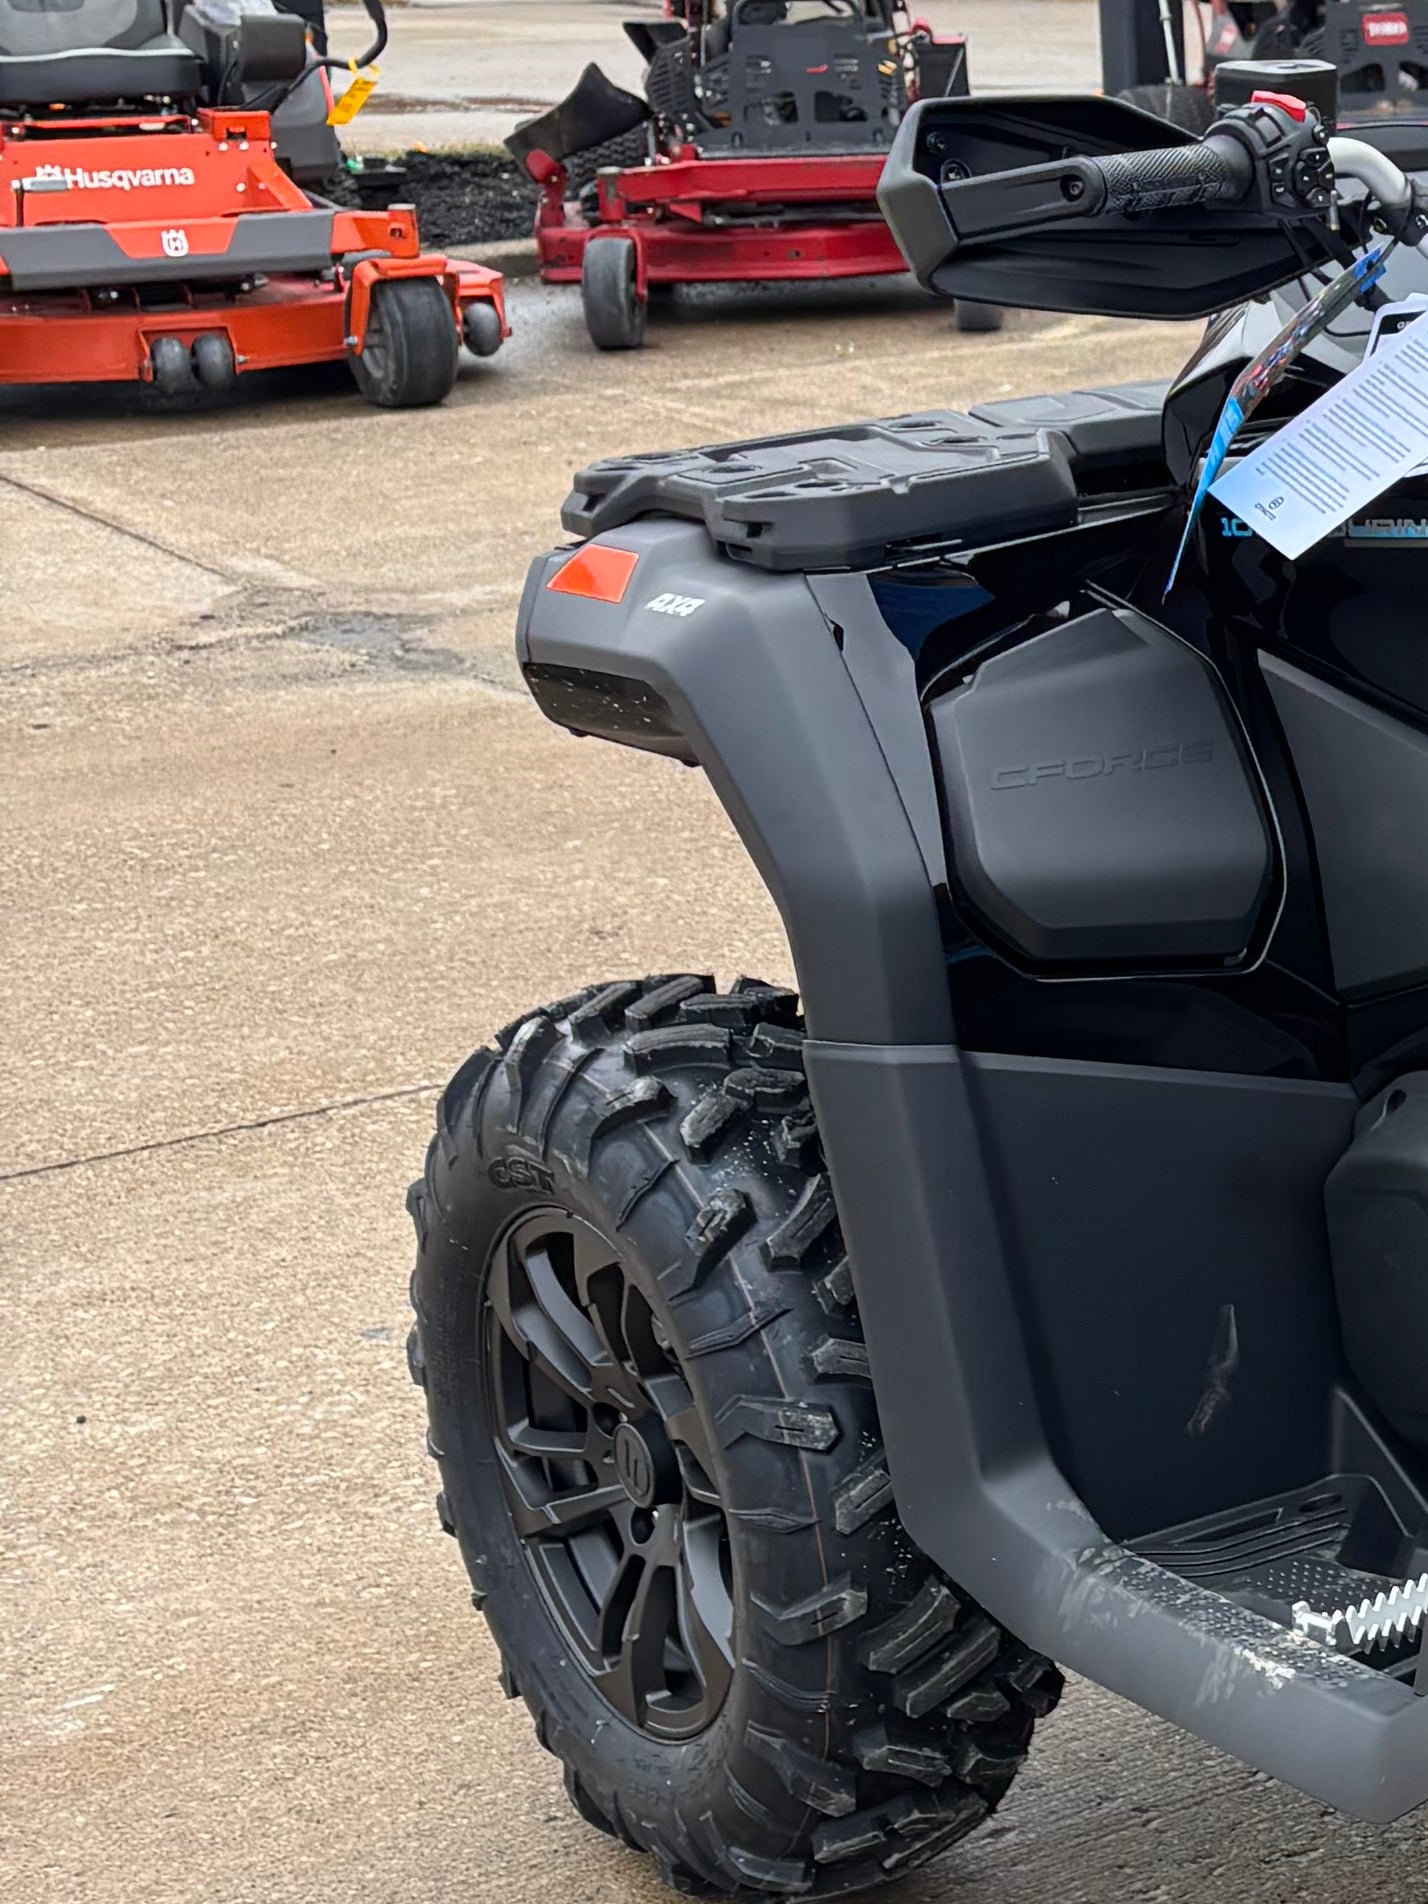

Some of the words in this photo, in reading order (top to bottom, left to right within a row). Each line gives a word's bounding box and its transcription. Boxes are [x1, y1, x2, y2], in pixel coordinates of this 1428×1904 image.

[64, 166, 196, 191] Husqvarna
[990, 741, 1214, 791] CFORCE
[487, 1155, 556, 1196] CST
